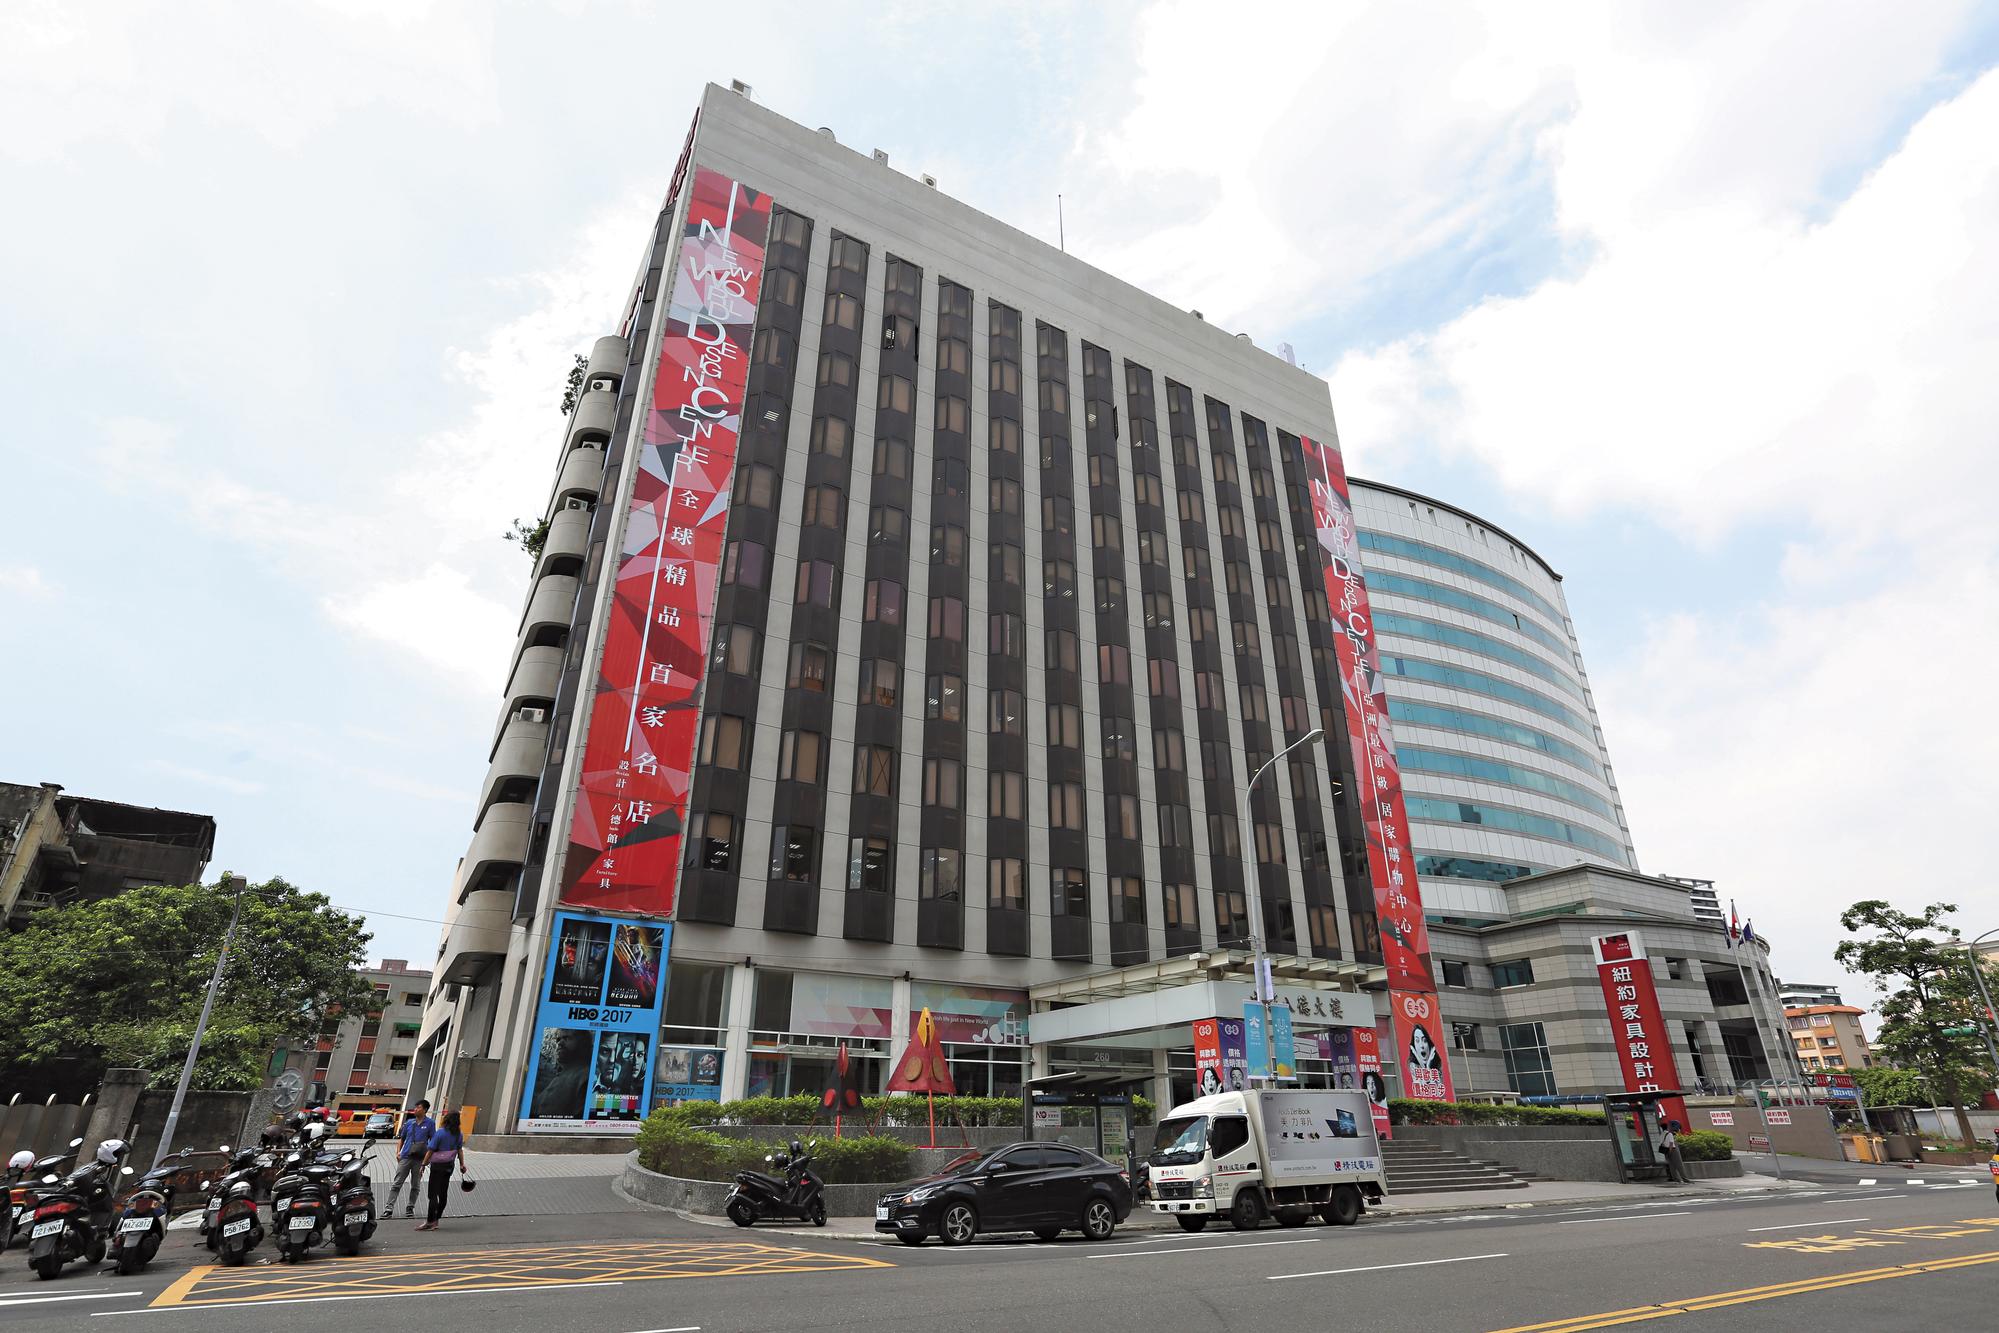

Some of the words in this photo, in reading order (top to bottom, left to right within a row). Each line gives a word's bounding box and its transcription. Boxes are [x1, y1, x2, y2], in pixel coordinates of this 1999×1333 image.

[568, 1007, 599, 1021] HBO
[601, 1009, 633, 1024] 2017
[1094, 1052, 1110, 1062] 260
[1035, 1110, 1047, 1119] NO
